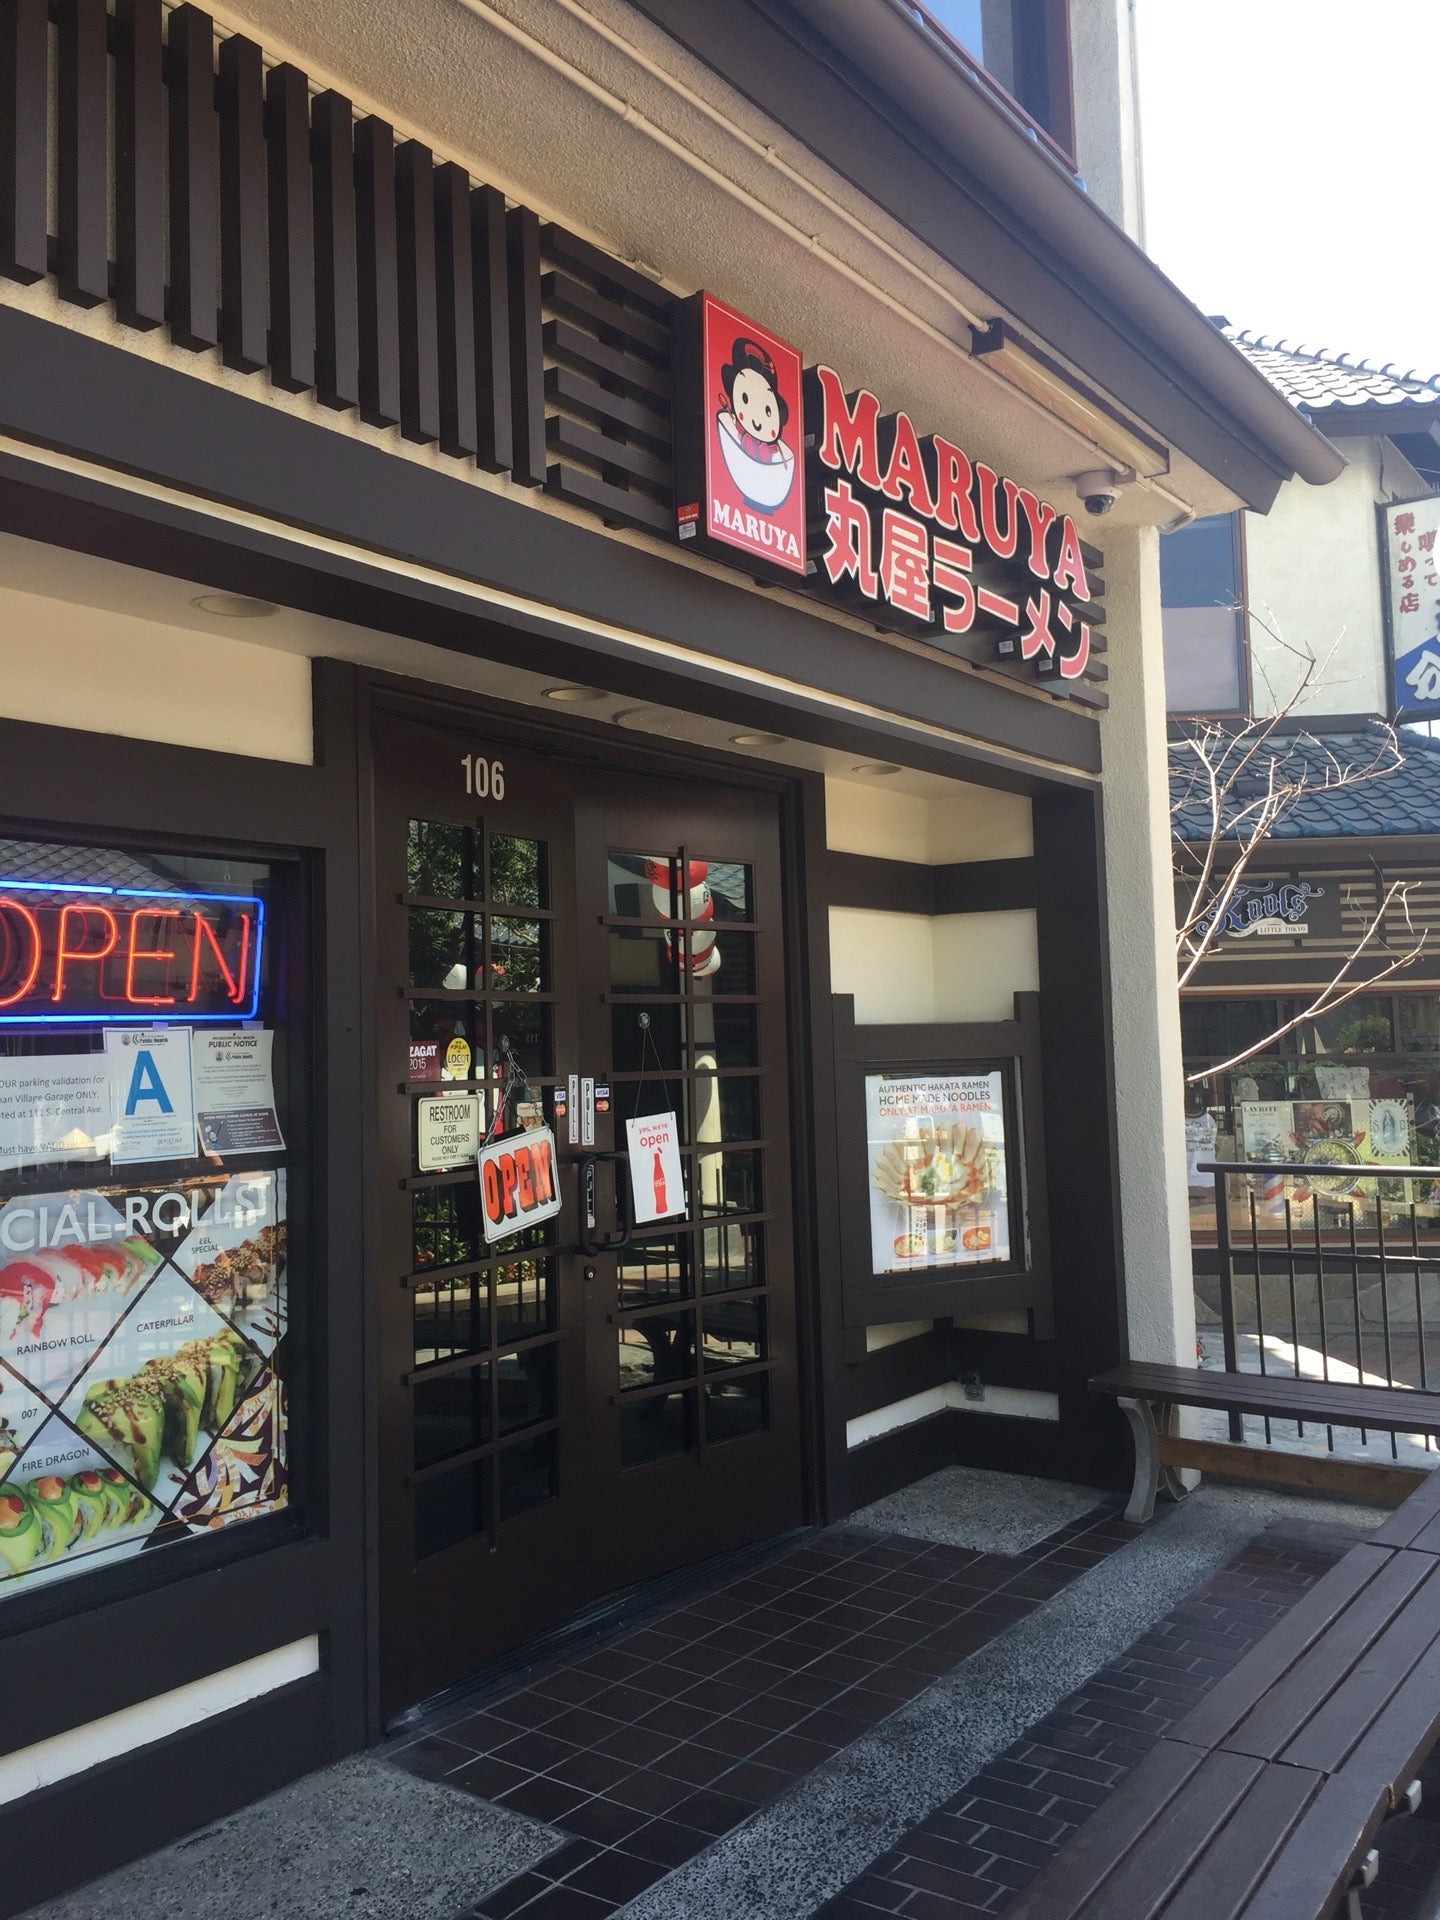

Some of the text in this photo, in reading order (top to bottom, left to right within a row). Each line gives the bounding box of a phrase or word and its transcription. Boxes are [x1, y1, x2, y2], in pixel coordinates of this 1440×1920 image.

[817, 364, 1090, 602] MARUYA
[713, 499, 800, 559] MARUYA
[823, 477, 1090, 679] 丸屋ラーメン
[461, 754, 504, 801] 106
[1284, 925, 1306, 933] TOKYO
[208, 1039, 258, 1048] PUBLIC NOTICE
[410, 1044, 437, 1058] ZAGAT
[410, 1057, 427, 1070] 2015
[19, 1078, 50, 1089] parking
[51, 1075, 91, 1086] validation
[93, 1074, 105, 1083] for
[125, 1050, 174, 1115] A
[879, 1080, 990, 1094] AUTHENTIC HAKATA RAMEN
[15, 1094, 43, 1103] Village
[44, 1093, 74, 1102] Garage
[943, 1090, 991, 1102] NOODLES
[17, 1110, 26, 1118] at
[55, 1106, 85, 1116] Central
[86, 1105, 104, 1114] Ave.
[430, 1104, 471, 1121] RESTROOM
[879, 1107, 904, 1117] ONLY
[960, 1101, 991, 1112] RAMEN
[443, 1124, 457, 1134] FOR
[430, 1133, 470, 1146] CUSTOMERS
[640, 1132, 670, 1148] open
[441, 1145, 459, 1155] ONLY
[483, 1139, 556, 1225] OPEN
[199, 1237, 212, 1245] EEL
[191, 1244, 220, 1255] SPECIAL
[136, 1315, 195, 1333] CATERPILLAR
[16, 1333, 96, 1356] RAINBOW ROLL
[21, 1408, 38, 1420] 007
[22, 1447, 90, 1472] FIRE DRAGON
